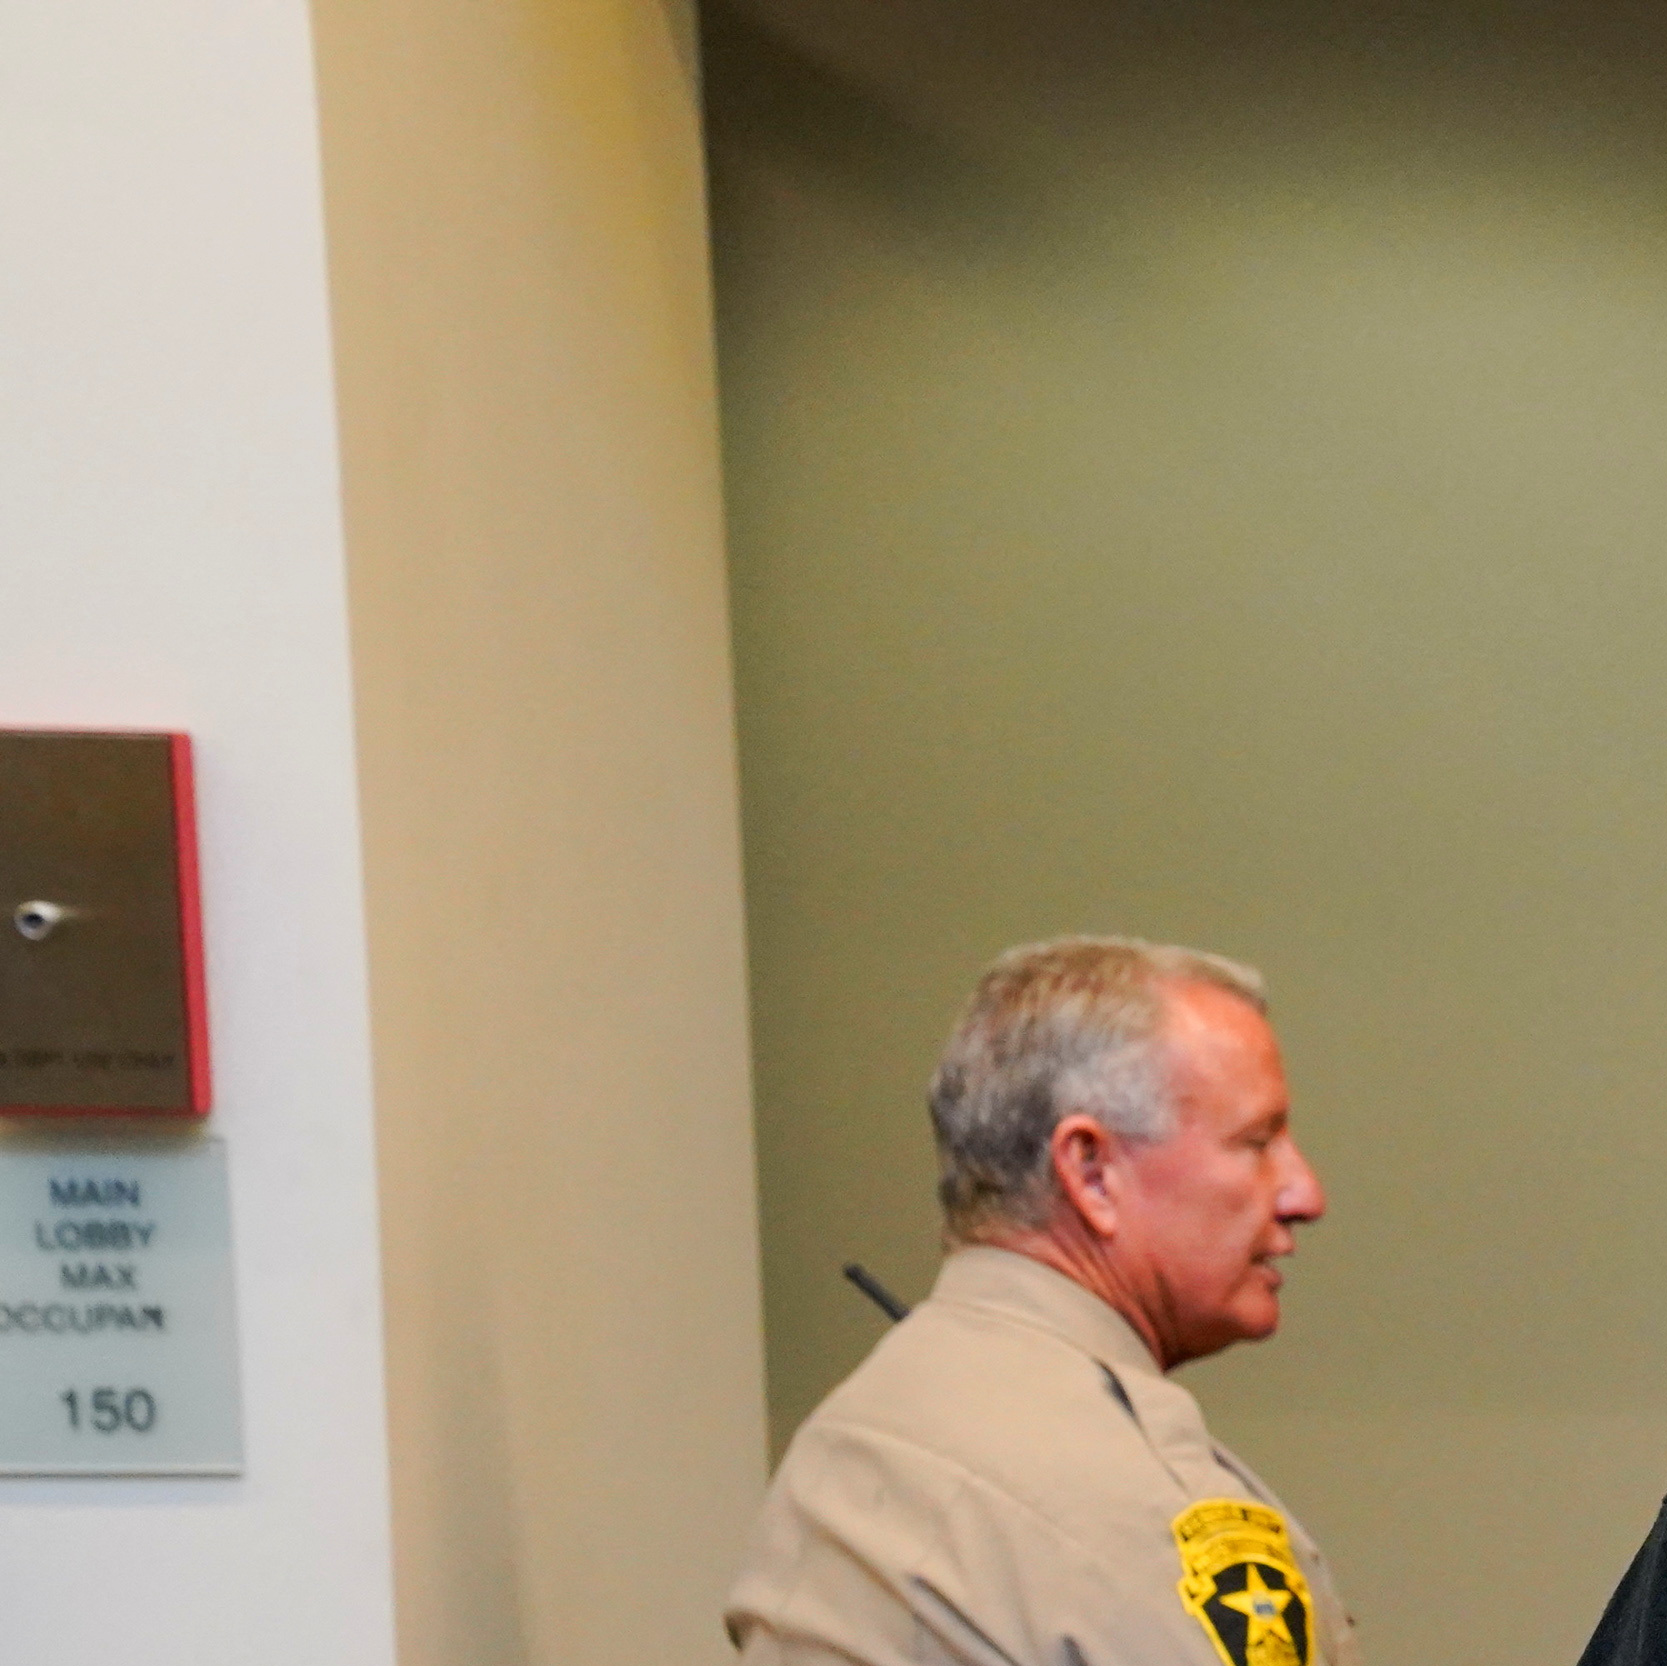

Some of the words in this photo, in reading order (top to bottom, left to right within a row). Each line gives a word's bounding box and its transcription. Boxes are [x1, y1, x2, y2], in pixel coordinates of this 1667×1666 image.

[48, 1179, 140, 1207] MAIN
[34, 1220, 156, 1252] LOBBY
[59, 1262, 137, 1290] MAX
[58, 1386, 157, 1434] 150
